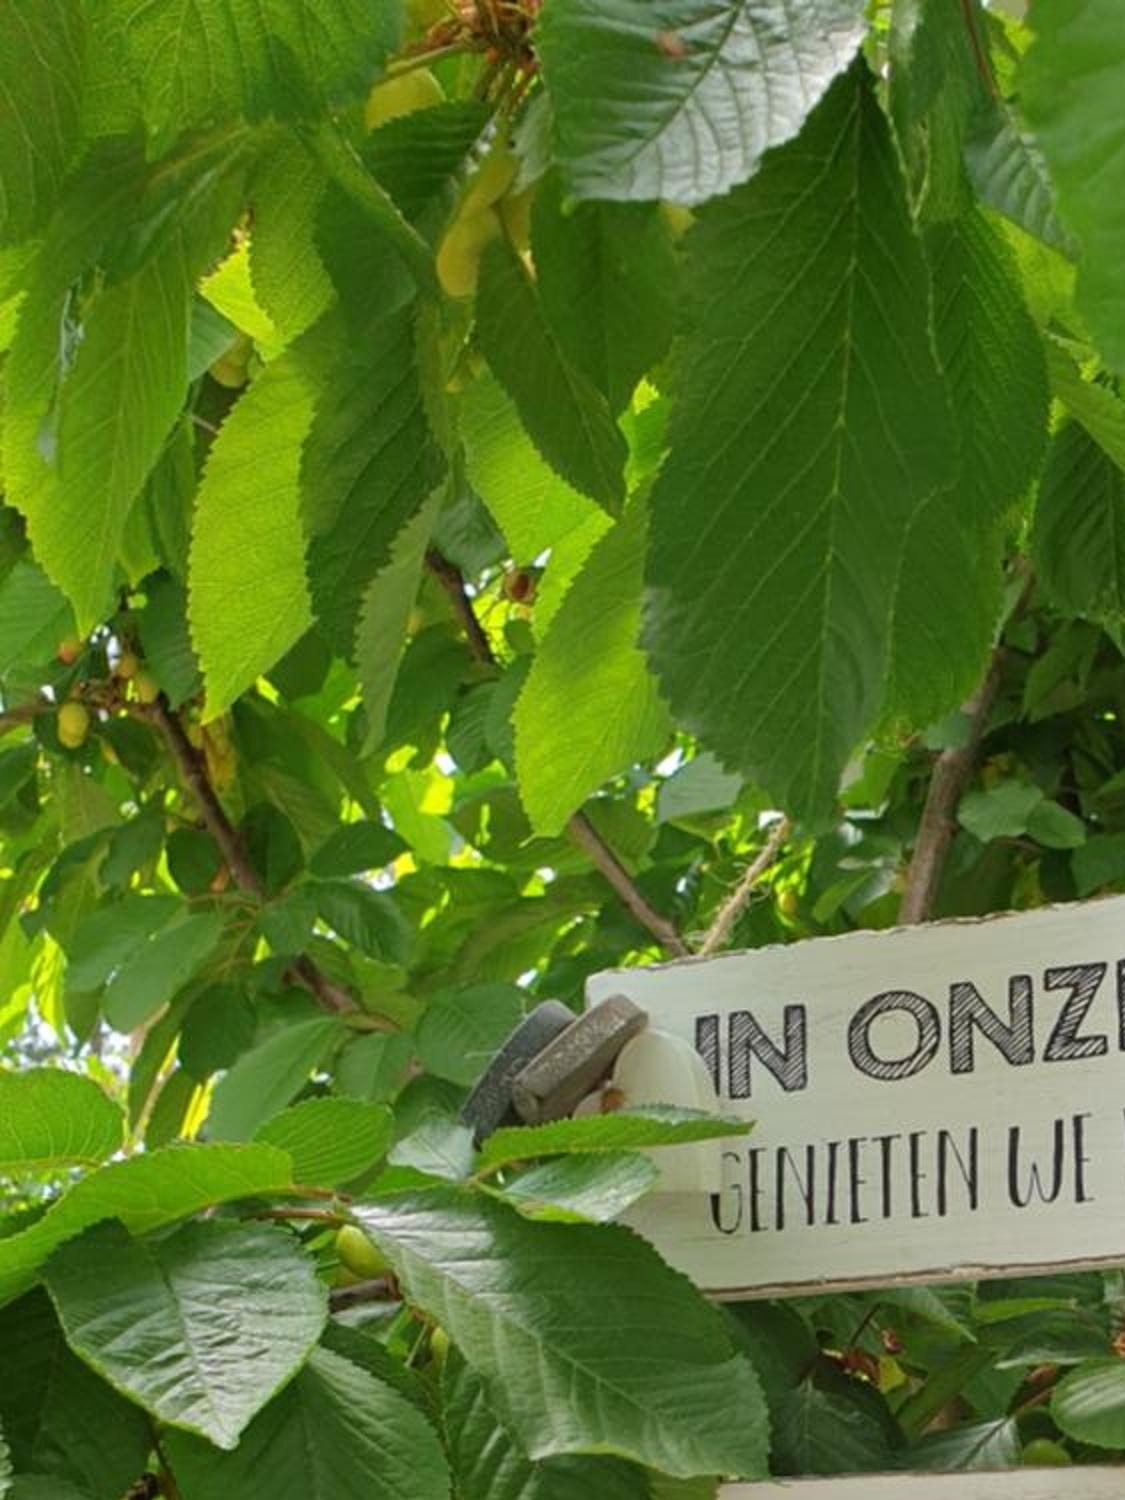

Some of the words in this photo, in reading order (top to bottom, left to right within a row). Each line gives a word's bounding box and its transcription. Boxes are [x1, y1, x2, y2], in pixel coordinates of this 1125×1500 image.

[695, 1004, 807, 1099] IN
[709, 1127, 979, 1235] GENIETEN
[1007, 1112, 1095, 1208] WE
